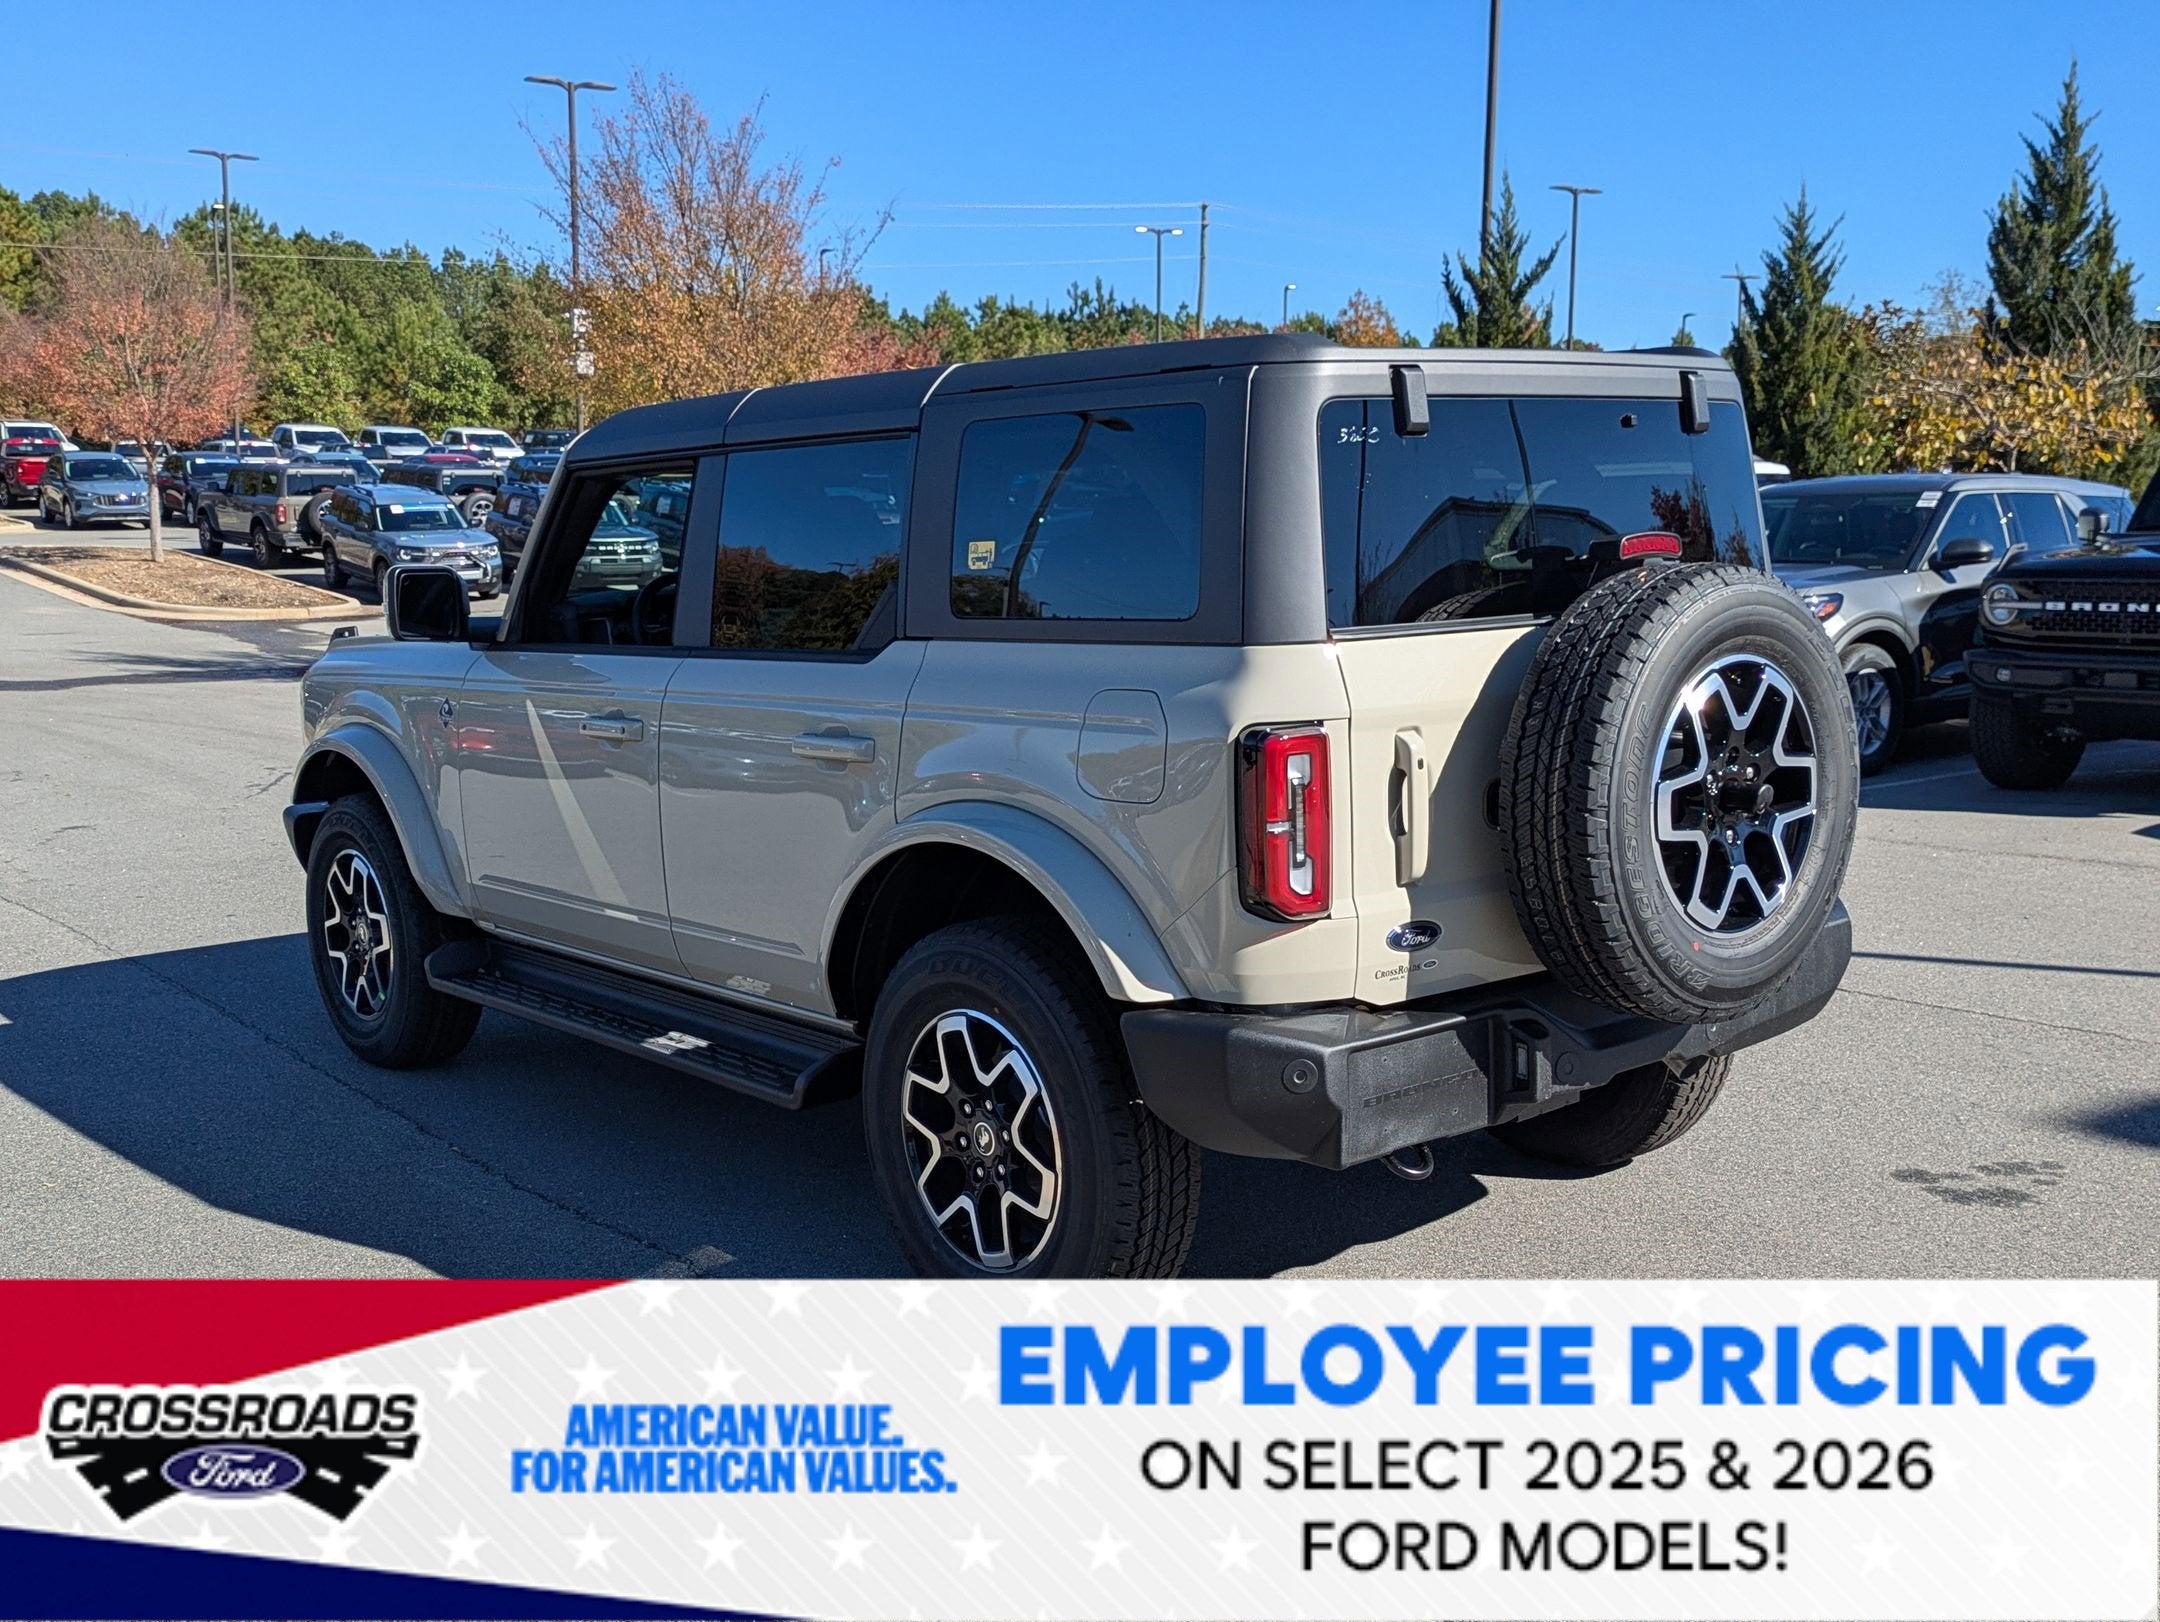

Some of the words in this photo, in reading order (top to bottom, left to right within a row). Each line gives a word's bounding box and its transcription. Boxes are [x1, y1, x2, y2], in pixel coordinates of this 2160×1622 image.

[2045, 601, 2160, 612] BRON
[1620, 702, 1712, 993] BRIDGESTONE
[1401, 929, 1431, 946] Ford
